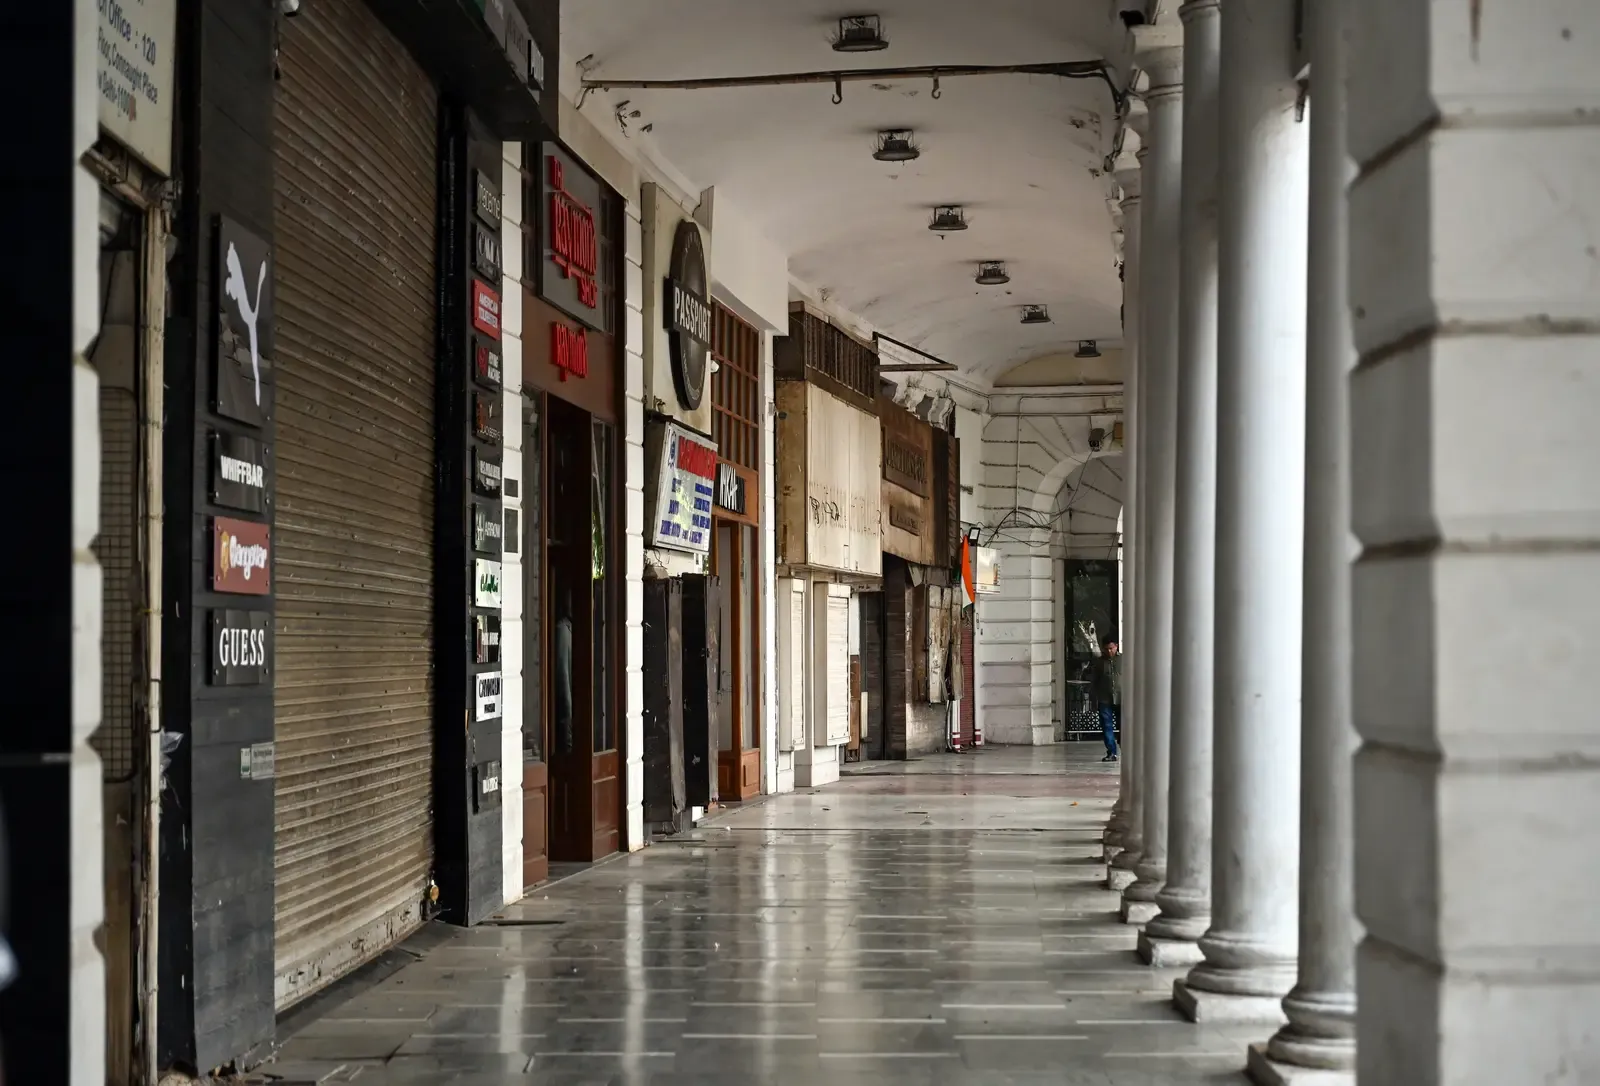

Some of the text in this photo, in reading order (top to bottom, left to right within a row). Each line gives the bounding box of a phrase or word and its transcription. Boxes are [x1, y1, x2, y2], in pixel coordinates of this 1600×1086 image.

[108, 0, 132, 42] Office
[142, 33, 157, 67] 120
[111, 42, 142, 91] Connaught
[142, 72, 158, 104] Place
[674, 286, 712, 344] PASSPORT
[221, 455, 264, 488] WHIFFBAR
[485, 521, 501, 538] ARROW
[219, 627, 265, 666] GUESS
